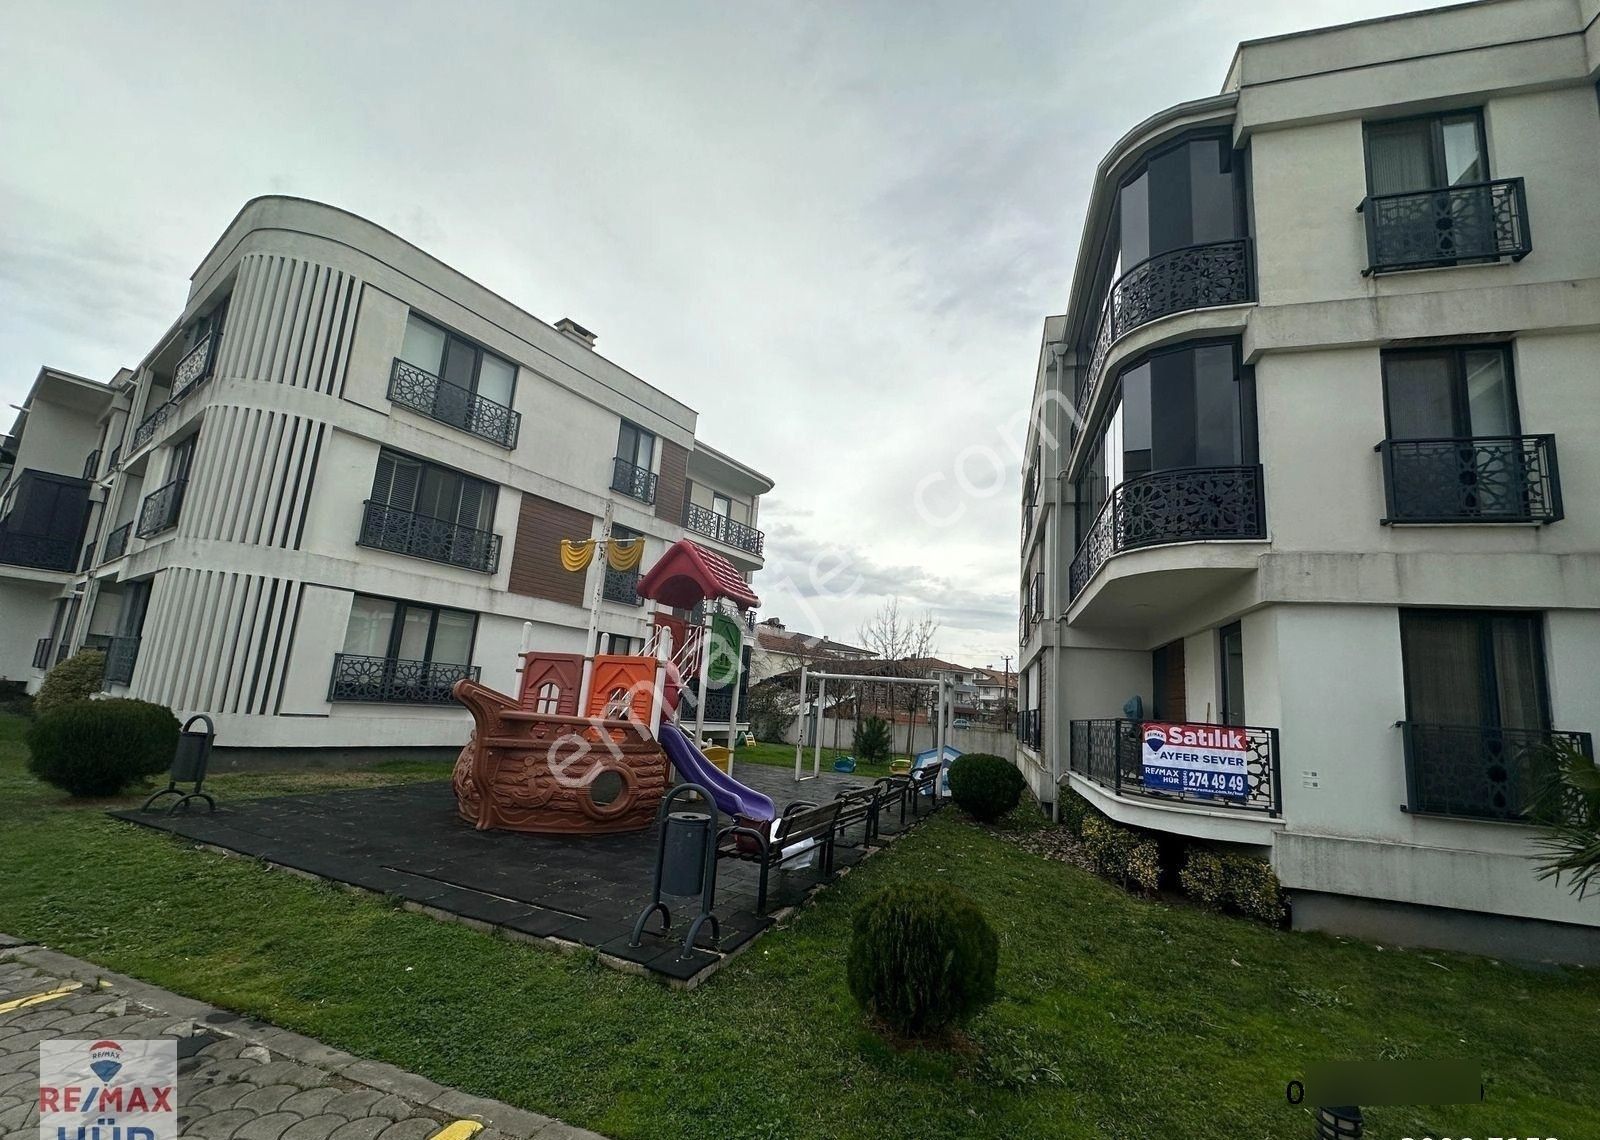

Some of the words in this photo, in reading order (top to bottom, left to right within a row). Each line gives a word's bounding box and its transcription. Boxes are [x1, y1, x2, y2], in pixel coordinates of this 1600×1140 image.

[1168, 726, 1243, 750] Satılık
[1160, 751, 1199, 763] AYFER
[1203, 755, 1245, 767] SEVER
[1145, 766, 1180, 778] RE/MAX
[1188, 771, 1209, 788] 274
[1211, 774, 1226, 790] 49
[1228, 775, 1244, 791] 49
